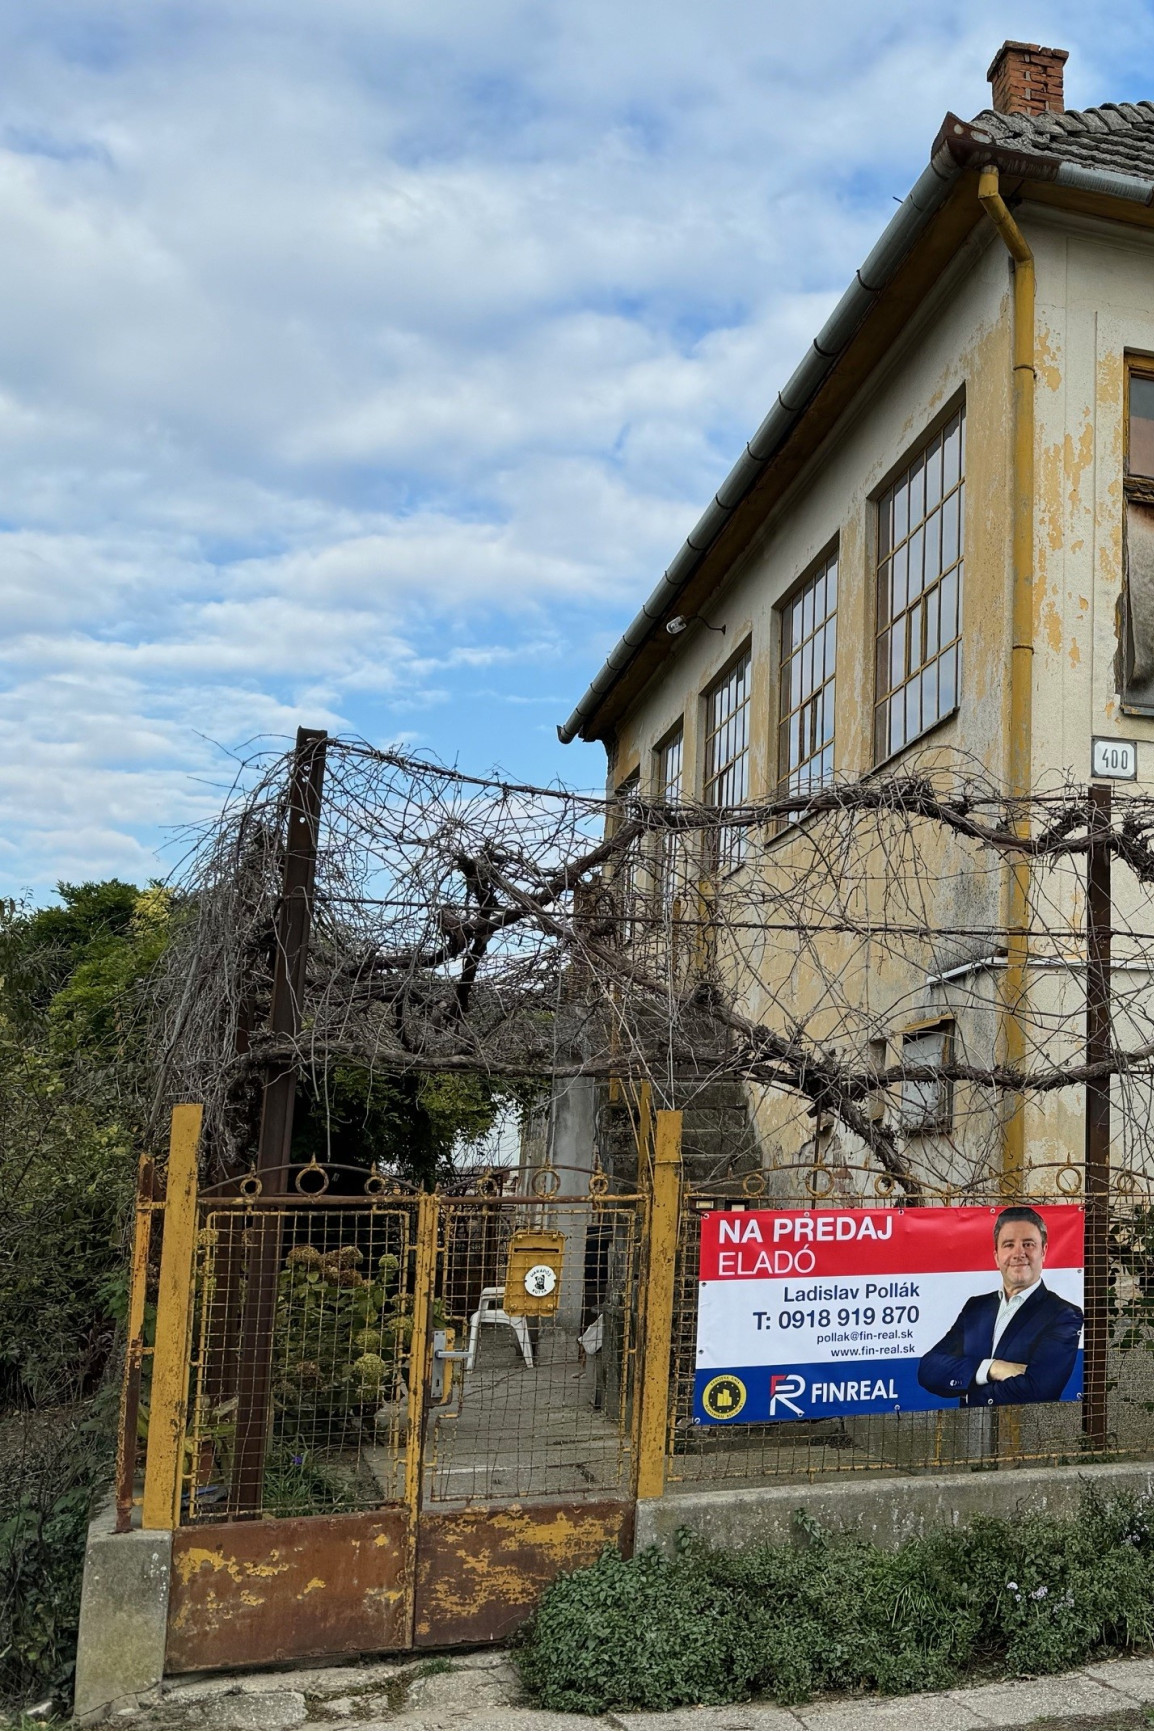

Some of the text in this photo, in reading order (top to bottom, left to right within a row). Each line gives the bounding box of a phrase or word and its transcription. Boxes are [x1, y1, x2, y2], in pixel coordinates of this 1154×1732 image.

[1102, 748, 1128, 770] 400
[719, 1215, 893, 1244] NA PREDAJ
[718, 1244, 816, 1275] ELADÓ
[783, 1281, 920, 1302] Ladislav Pollák
[753, 1305, 920, 1331] T: 0918 919 870
[816, 1329, 913, 1345] pollak@fin-real.sk
[830, 1344, 916, 1358] www.fin-real.sk
[811, 1379, 899, 1404] FINREAL
